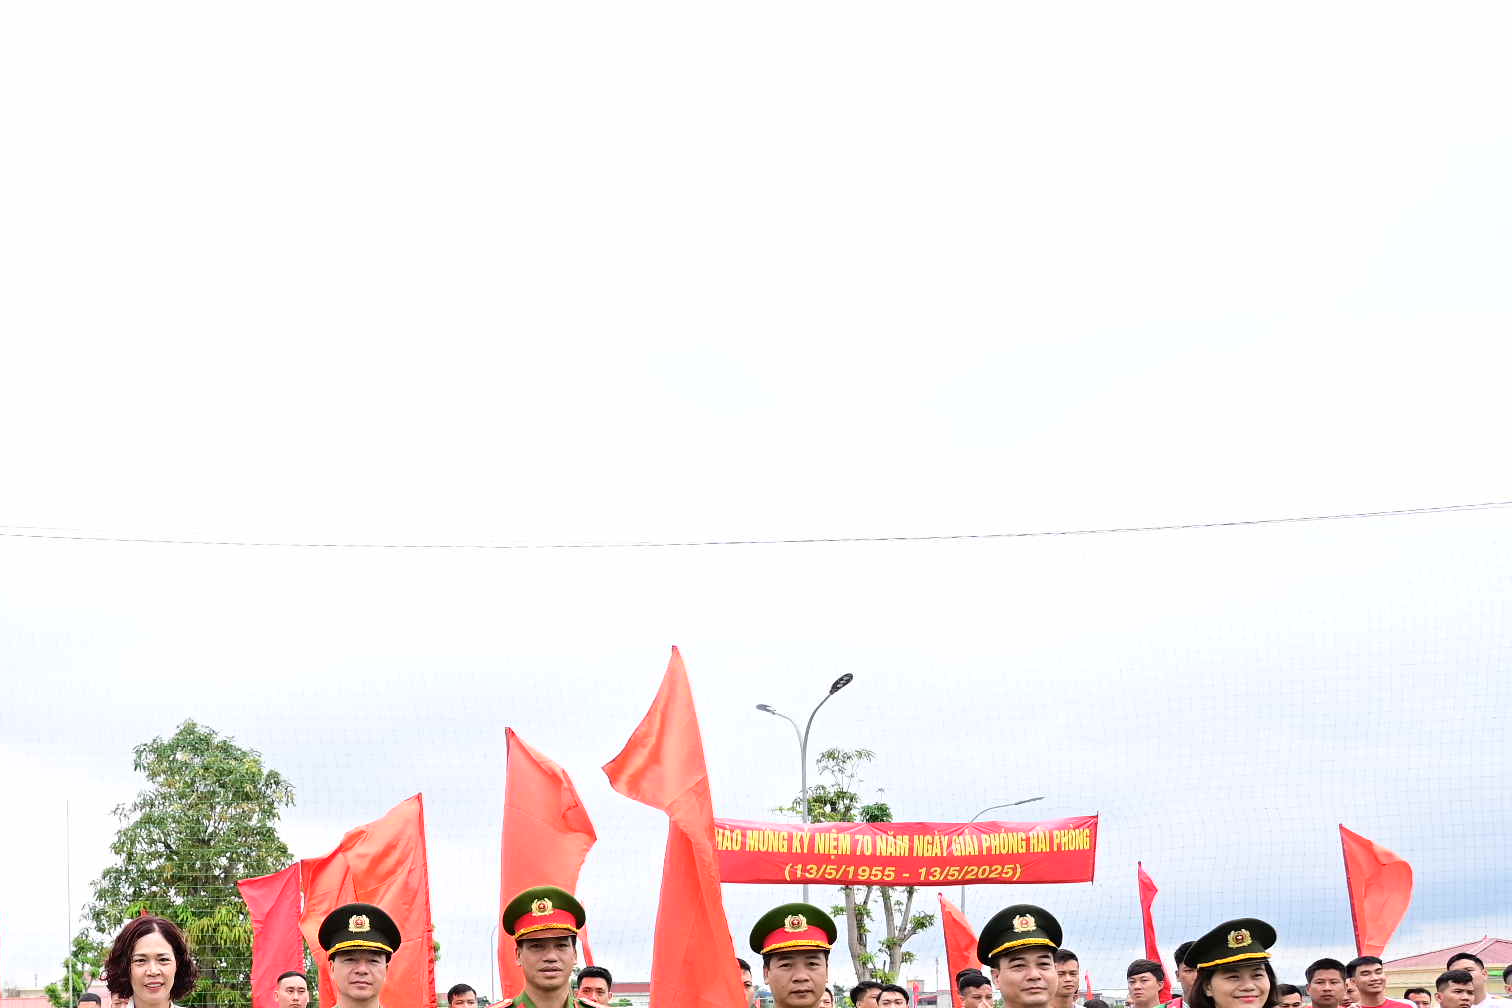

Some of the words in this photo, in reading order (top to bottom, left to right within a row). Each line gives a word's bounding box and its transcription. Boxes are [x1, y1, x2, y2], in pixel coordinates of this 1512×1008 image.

[715, 828, 741, 850] HÀO
[815, 829, 850, 859] NIỆM
[855, 834, 872, 855] 70
[877, 831, 910, 856] NĂM
[914, 831, 948, 856] NGÀY
[952, 828, 979, 856] GIẢI
[982, 828, 1026, 855] PHÓNG
[1054, 824, 1090, 851] PHÒNG
[785, 864, 896, 881] (13/5/1955
[918, 864, 1023, 881] 13/5/2025)
